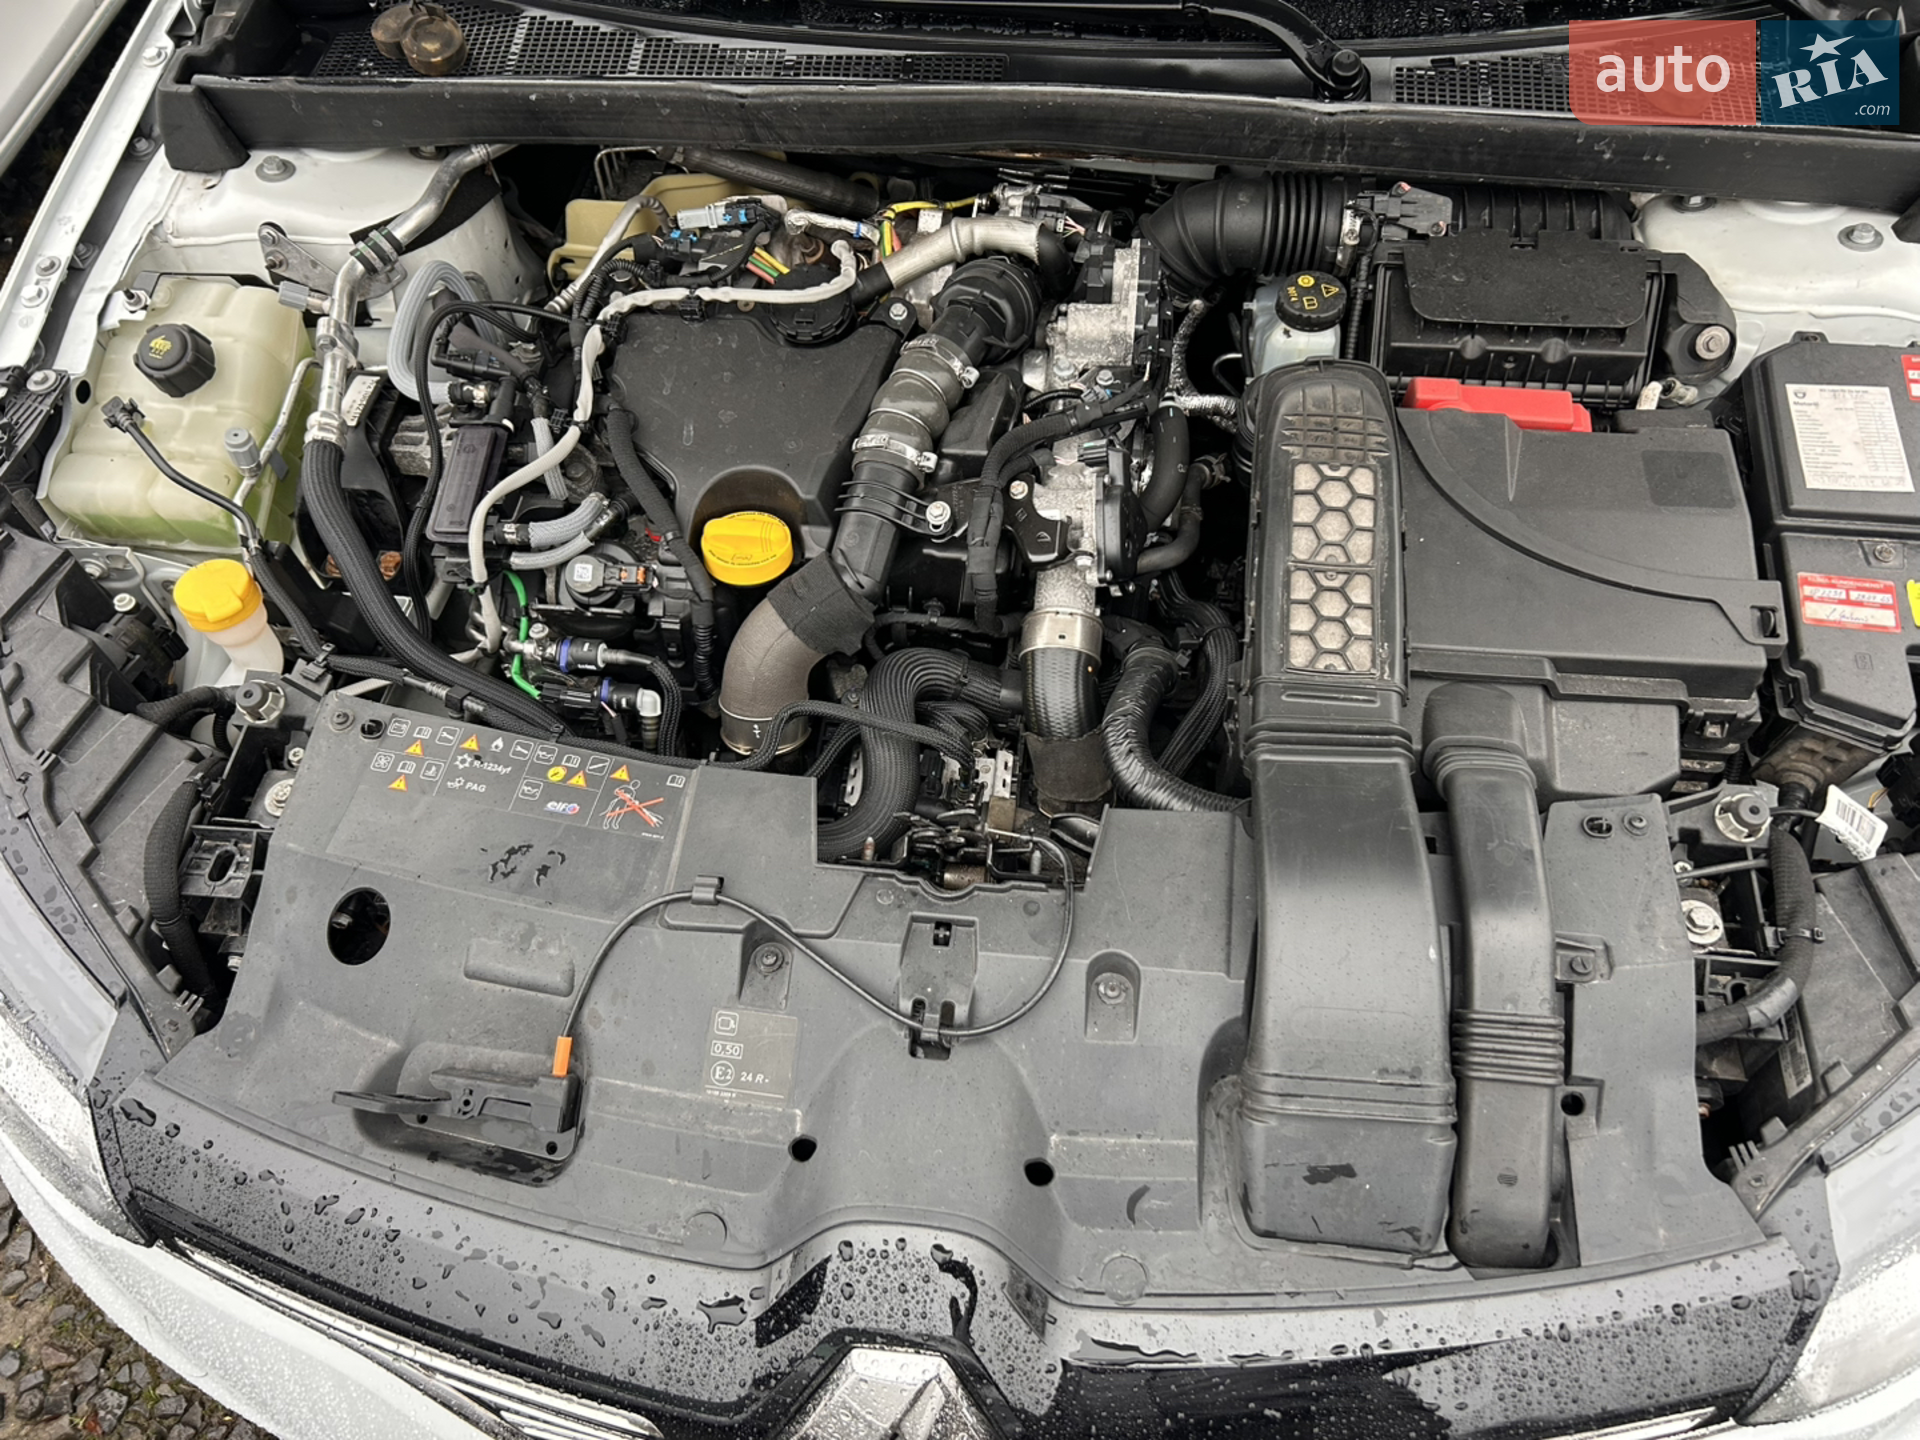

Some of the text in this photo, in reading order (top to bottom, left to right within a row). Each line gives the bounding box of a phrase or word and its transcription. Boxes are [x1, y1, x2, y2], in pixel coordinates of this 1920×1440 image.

[472, 759, 512, 776] R-1234yf
[465, 781, 487, 793] PAG
[714, 1043, 740, 1056] 0,50
[740, 1071, 753, 1082] 24
